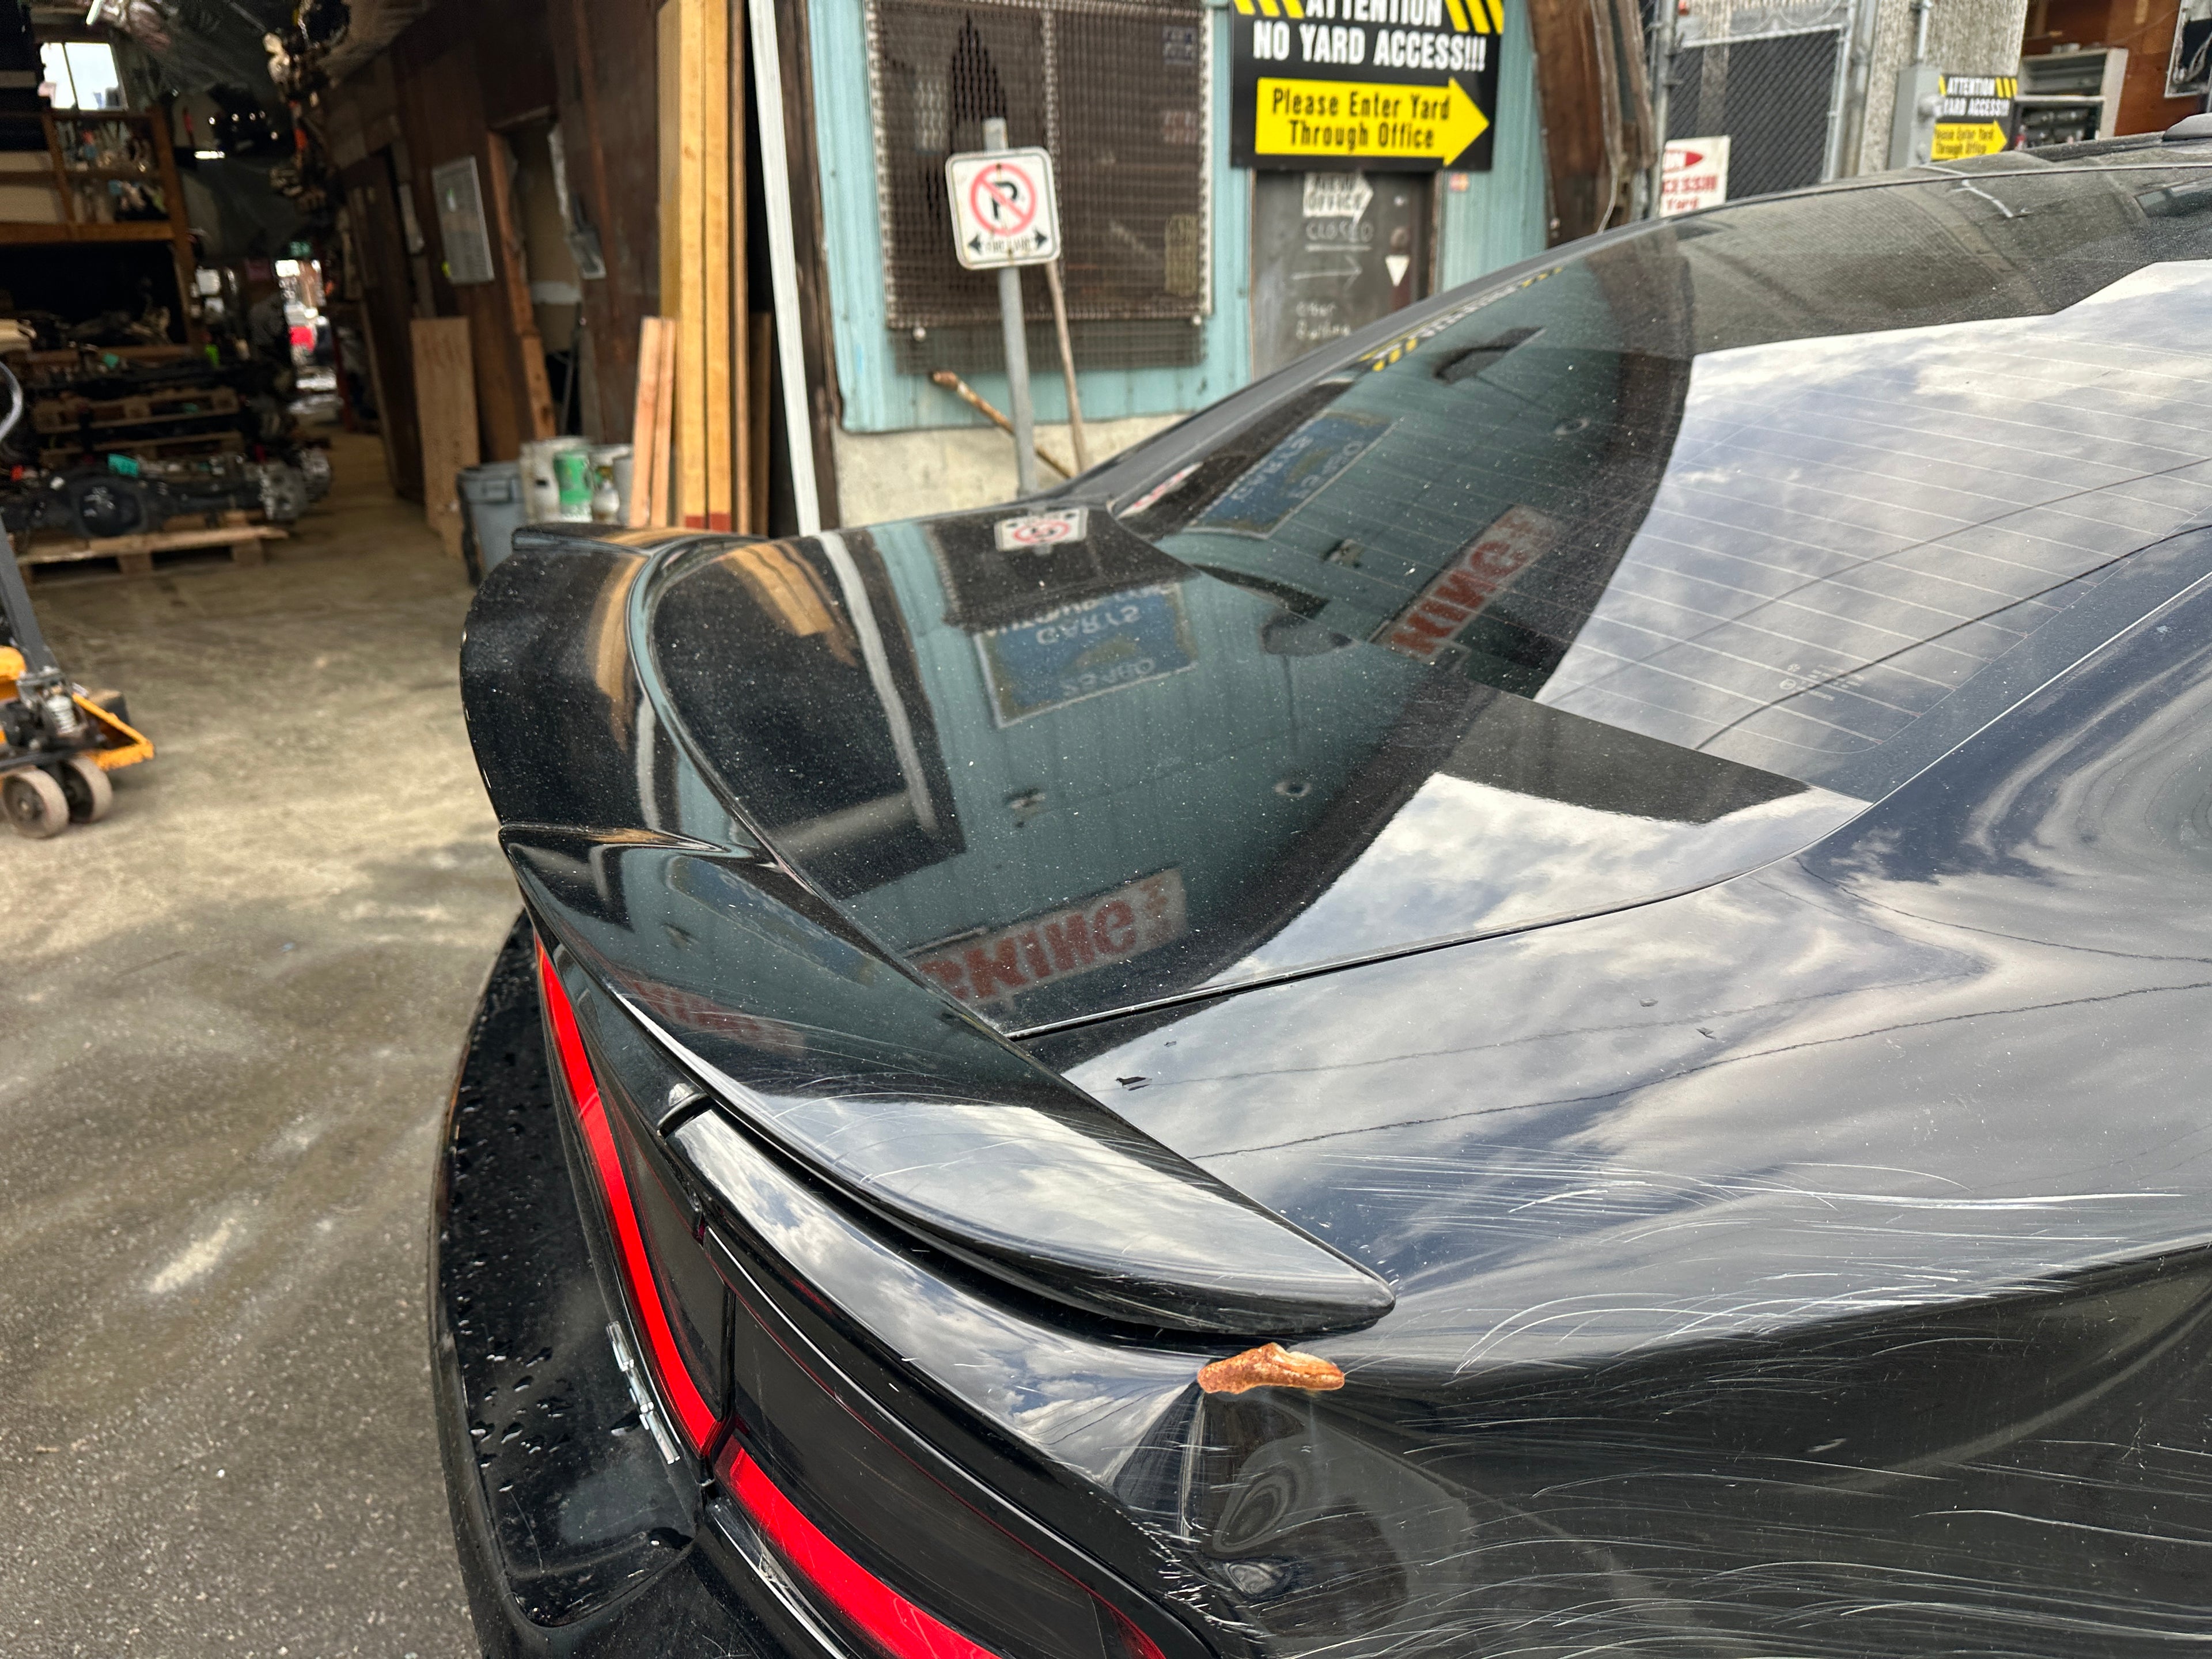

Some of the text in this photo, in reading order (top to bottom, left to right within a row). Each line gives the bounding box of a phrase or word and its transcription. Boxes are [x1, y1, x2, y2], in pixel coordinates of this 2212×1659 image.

[1253, 20, 1486, 71] NO YARD ACCESS!!!
[1272, 87, 1450, 120] Please Enter Yard
[1946, 77, 1995, 97] ATTENTION
[1289, 119, 1434, 154] Through Office
